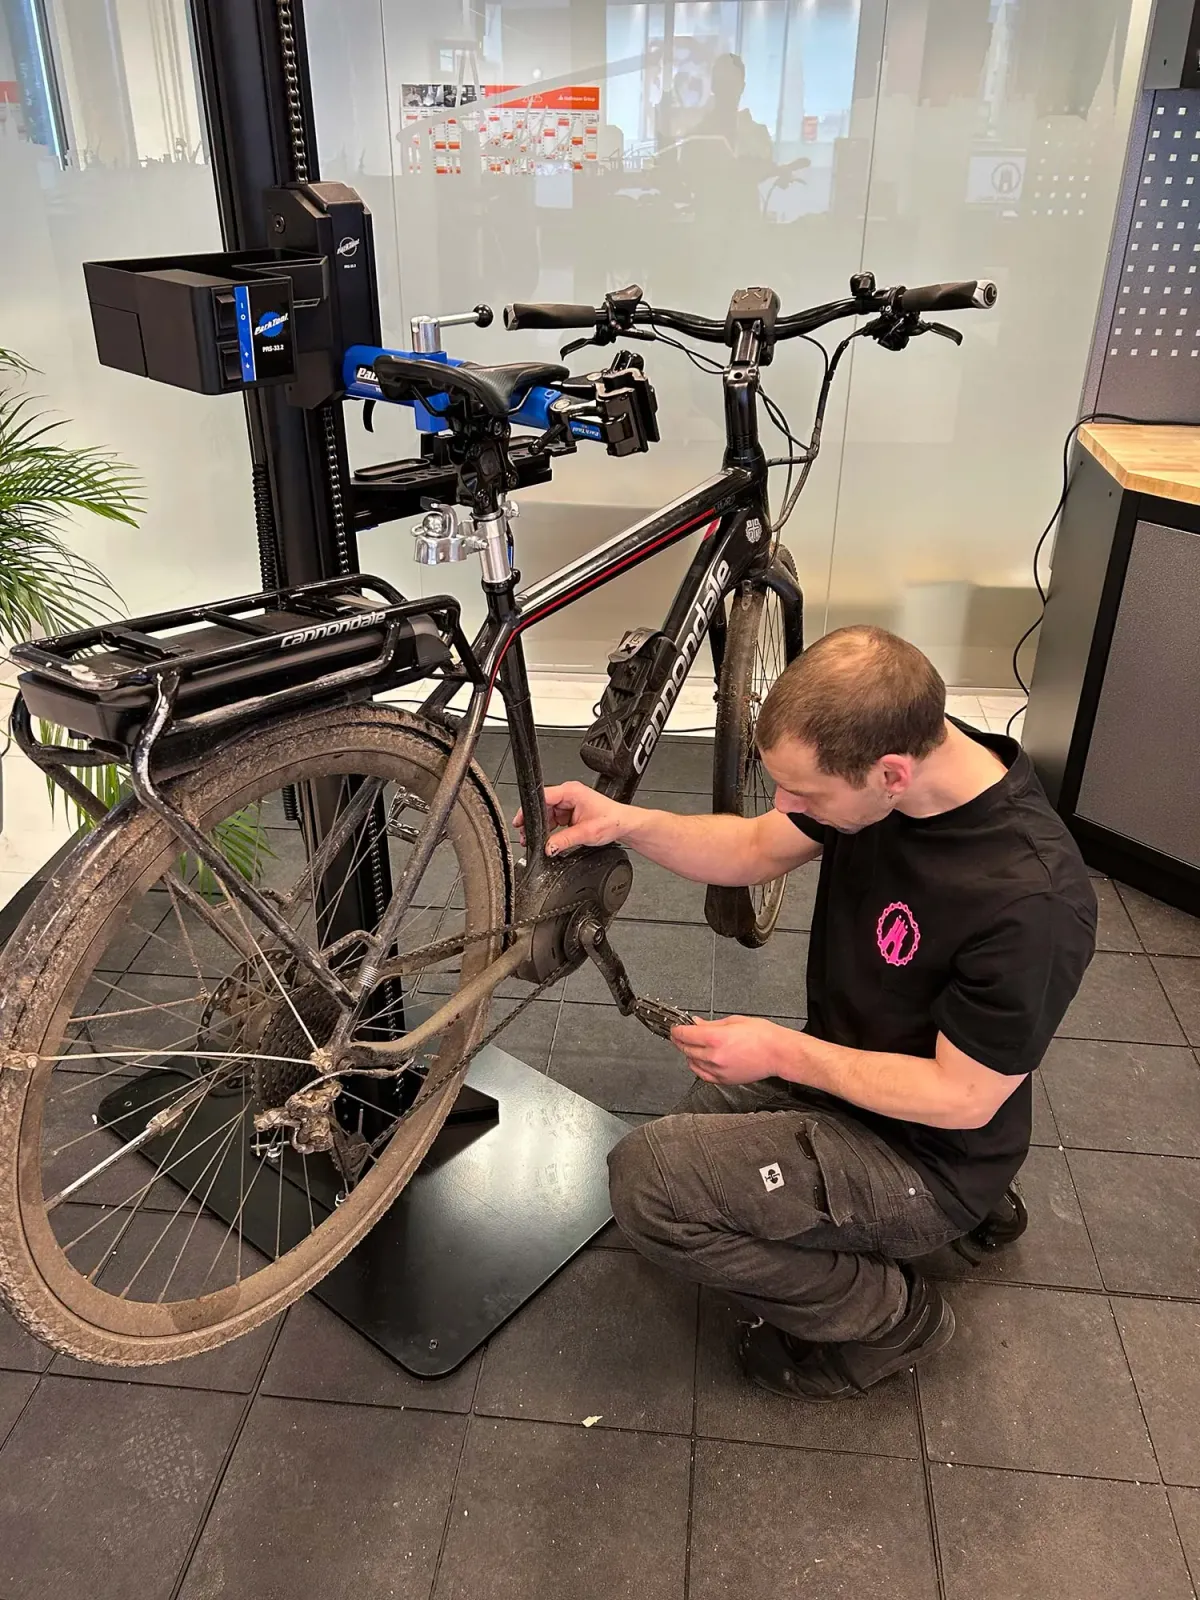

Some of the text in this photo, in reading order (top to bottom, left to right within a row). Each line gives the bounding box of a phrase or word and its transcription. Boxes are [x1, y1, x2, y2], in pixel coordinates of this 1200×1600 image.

[262, 344, 284, 353] PRS-33.2
[280, 611, 387, 648] cannondale
[632, 559, 731, 775] cannondale
